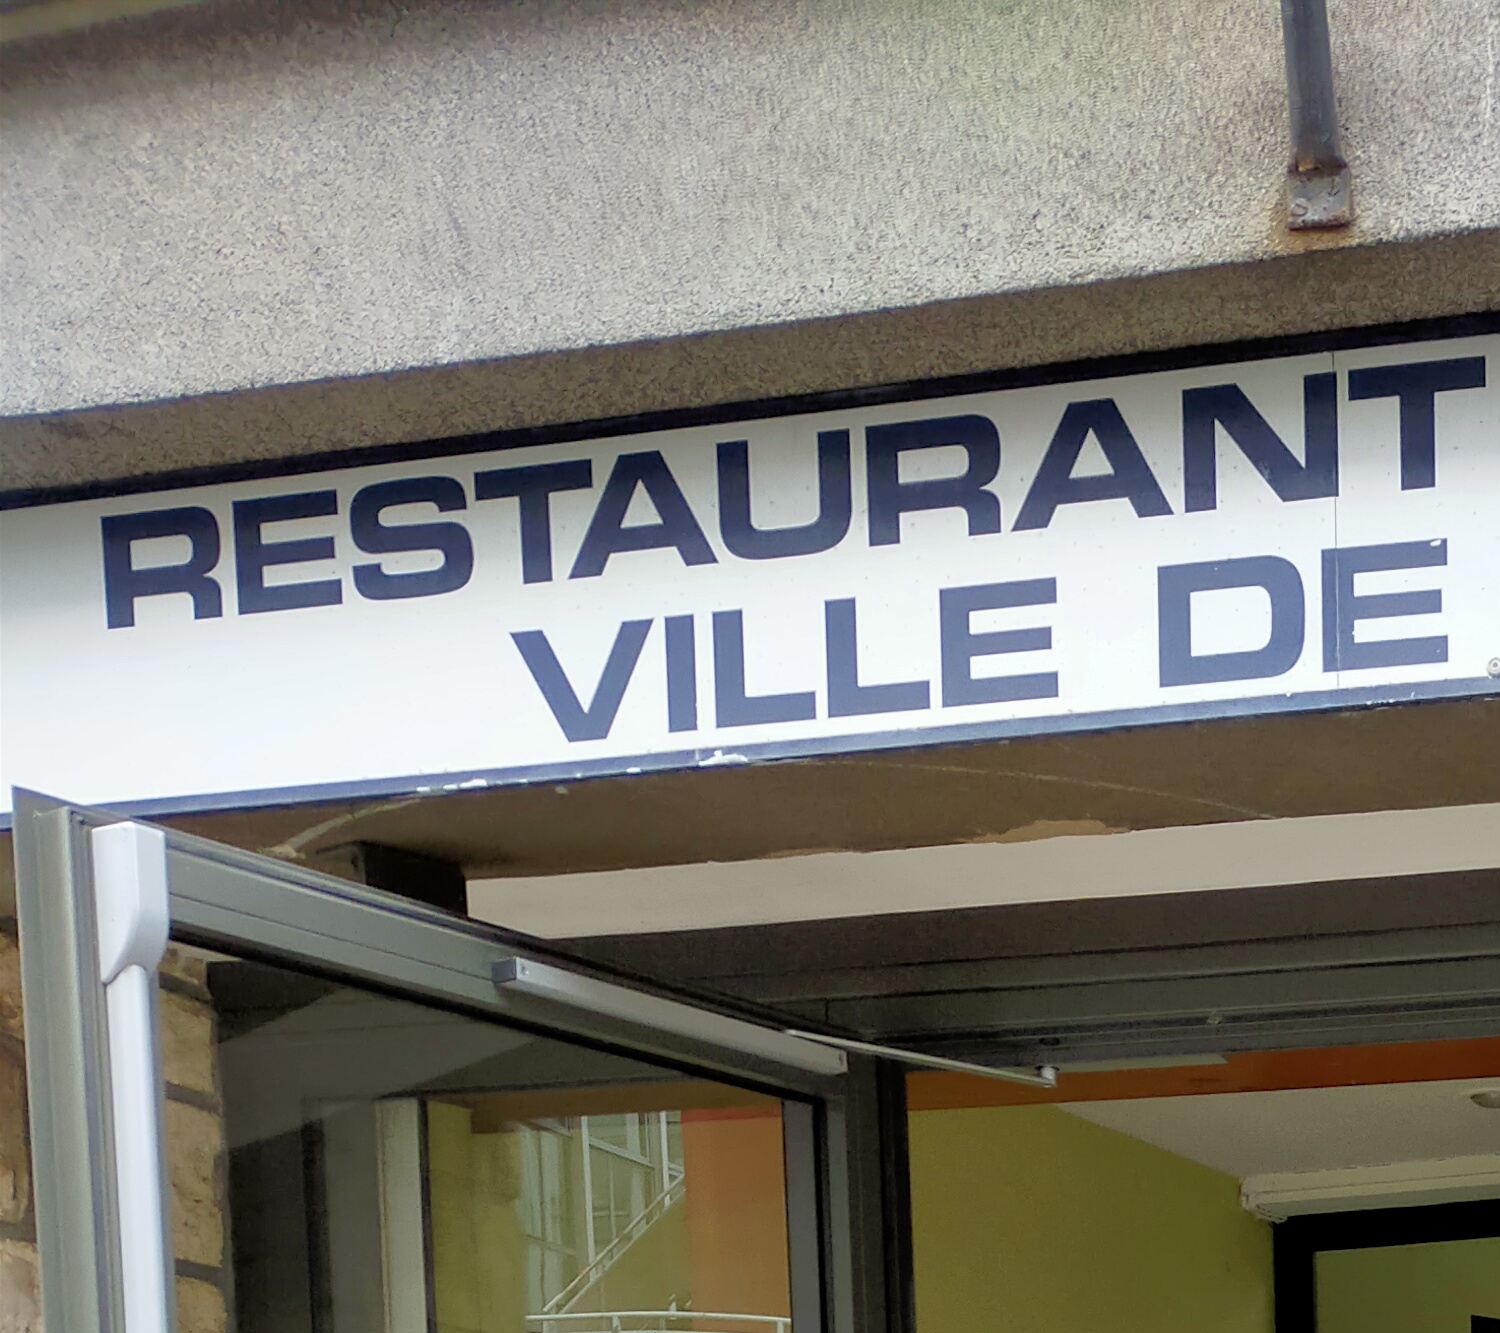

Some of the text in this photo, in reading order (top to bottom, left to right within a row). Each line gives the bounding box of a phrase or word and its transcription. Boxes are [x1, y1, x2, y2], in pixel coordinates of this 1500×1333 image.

[101, 355, 1487, 630] RESTAURANT
[510, 577, 1059, 743] VILLE
[1157, 537, 1450, 688] DE
